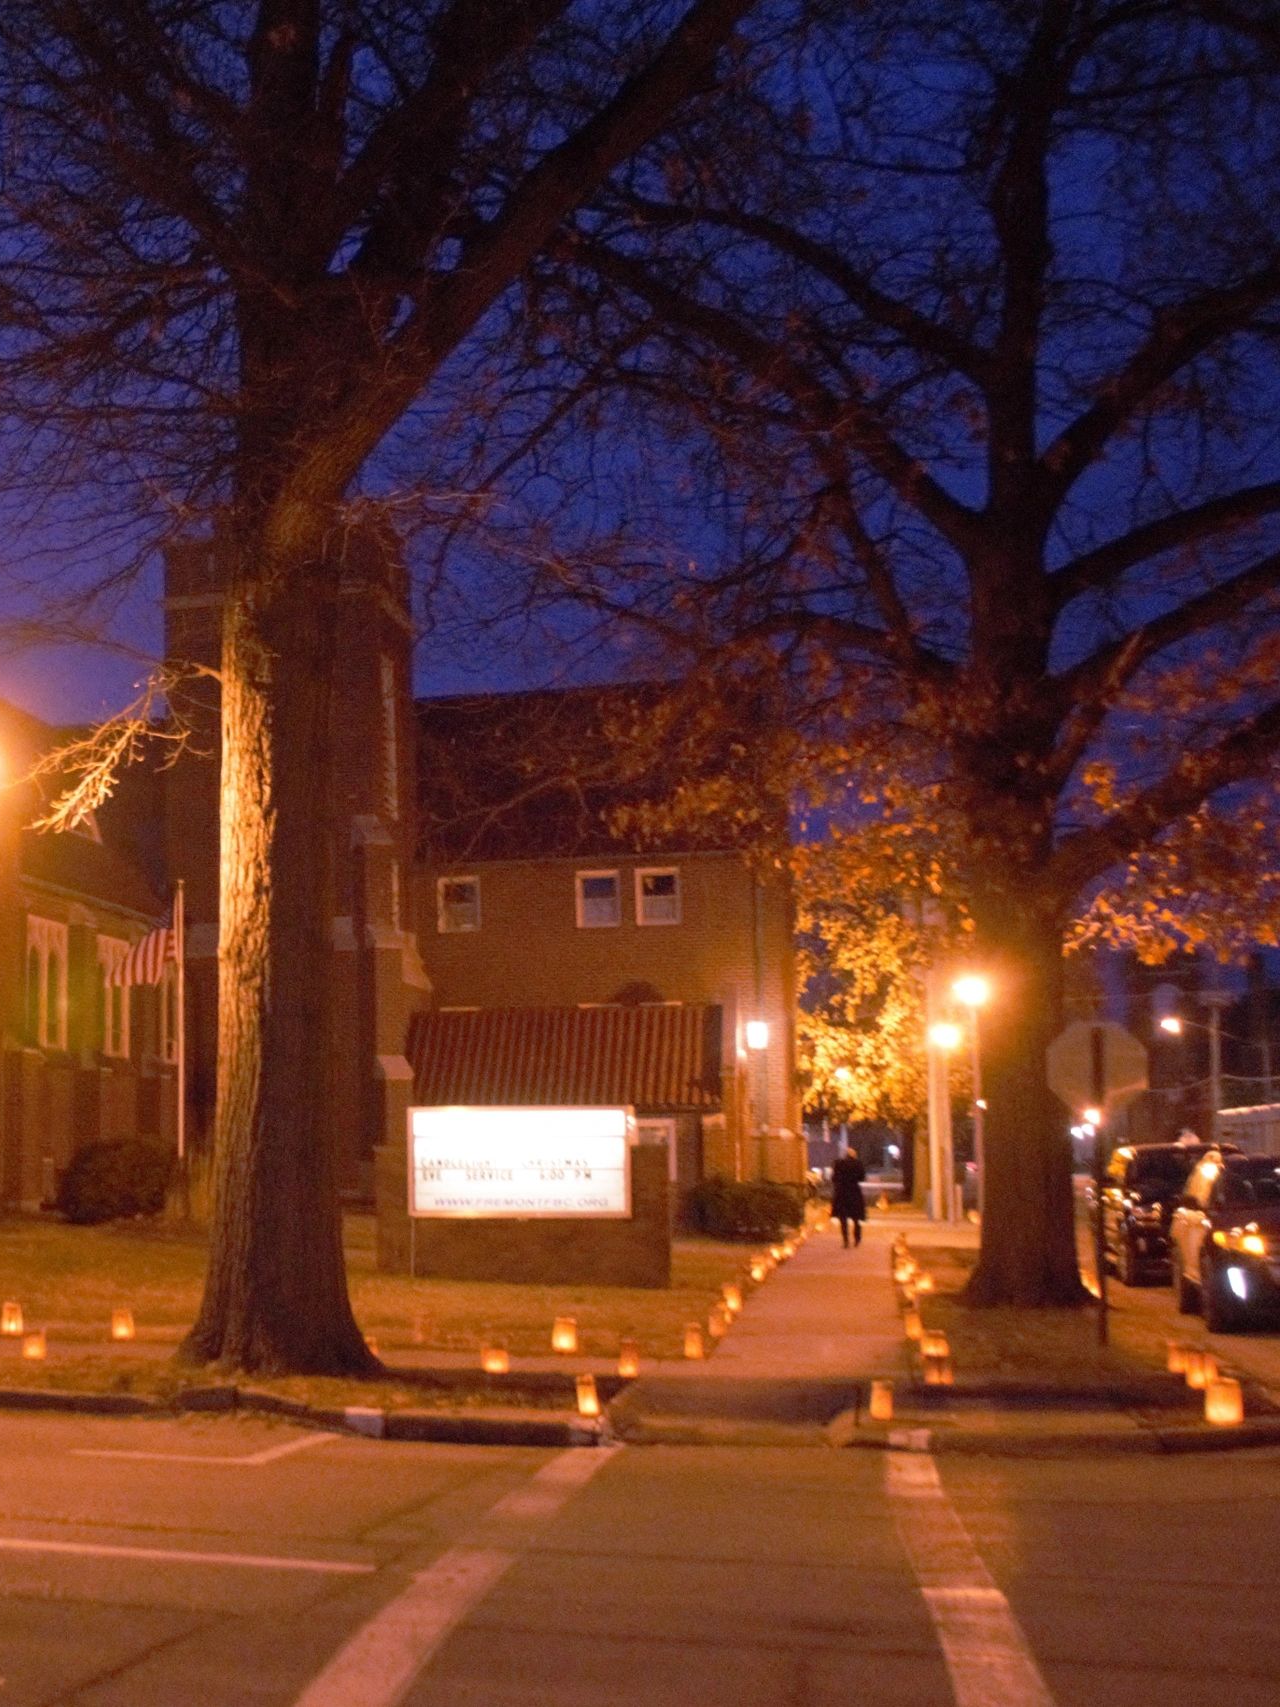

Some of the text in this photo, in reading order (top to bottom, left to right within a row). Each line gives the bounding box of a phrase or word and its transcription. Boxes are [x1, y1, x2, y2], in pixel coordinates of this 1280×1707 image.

[420, 1157, 496, 1169] CANDLELIGH
[421, 1169, 442, 1181] EVE
[465, 1168, 513, 1181] SERVICE
